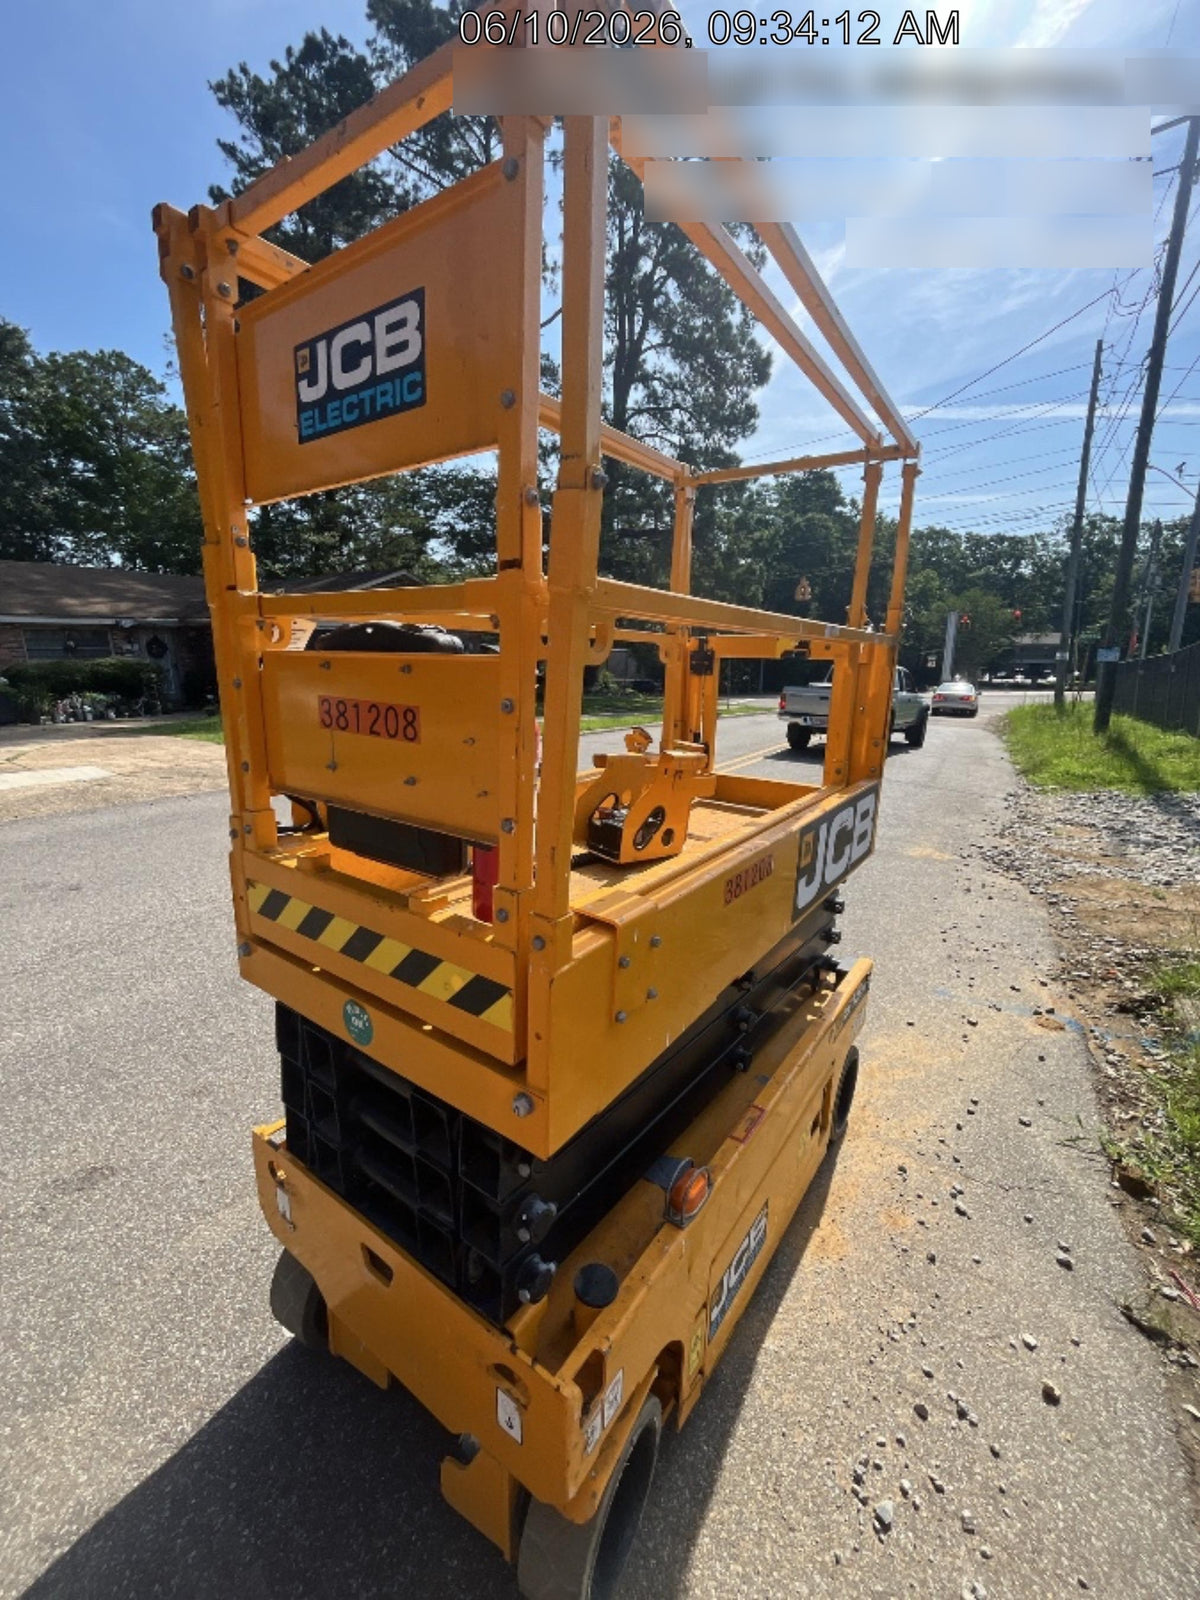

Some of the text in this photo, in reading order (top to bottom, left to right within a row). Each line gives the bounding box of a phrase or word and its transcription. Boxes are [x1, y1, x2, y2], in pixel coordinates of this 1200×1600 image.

[298, 300, 422, 402] JCB
[301, 371, 422, 436] ELECTRIC
[320, 698, 418, 742] 381208
[797, 793, 875, 909] JCB
[711, 1208, 767, 1321] JCB
